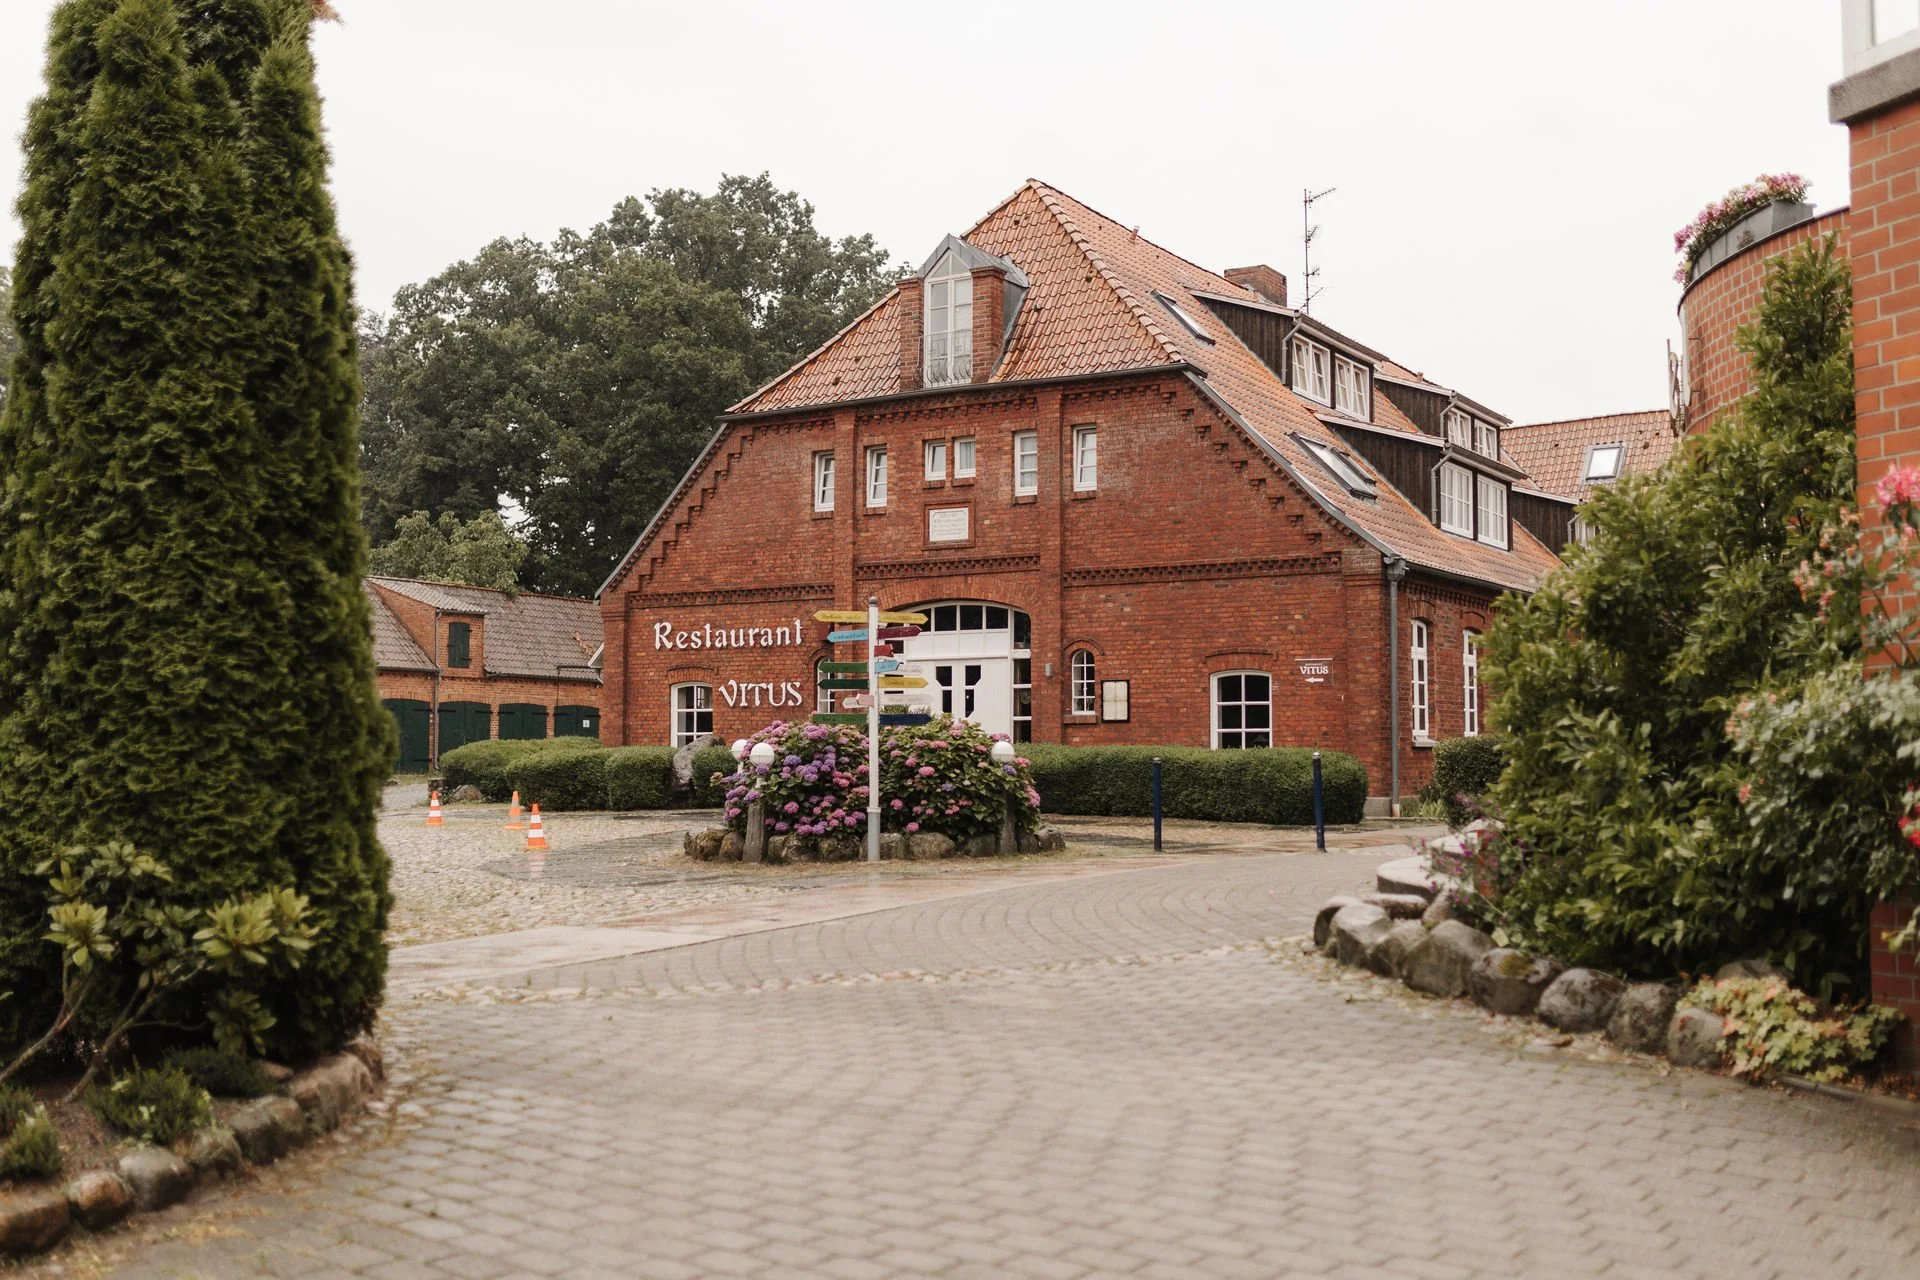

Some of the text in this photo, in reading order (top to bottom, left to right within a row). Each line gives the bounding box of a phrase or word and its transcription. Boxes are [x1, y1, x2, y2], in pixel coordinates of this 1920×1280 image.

[654, 619, 803, 650] Restaurant
[1300, 666, 1328, 674] VITUS
[718, 679, 803, 708] VITUS
